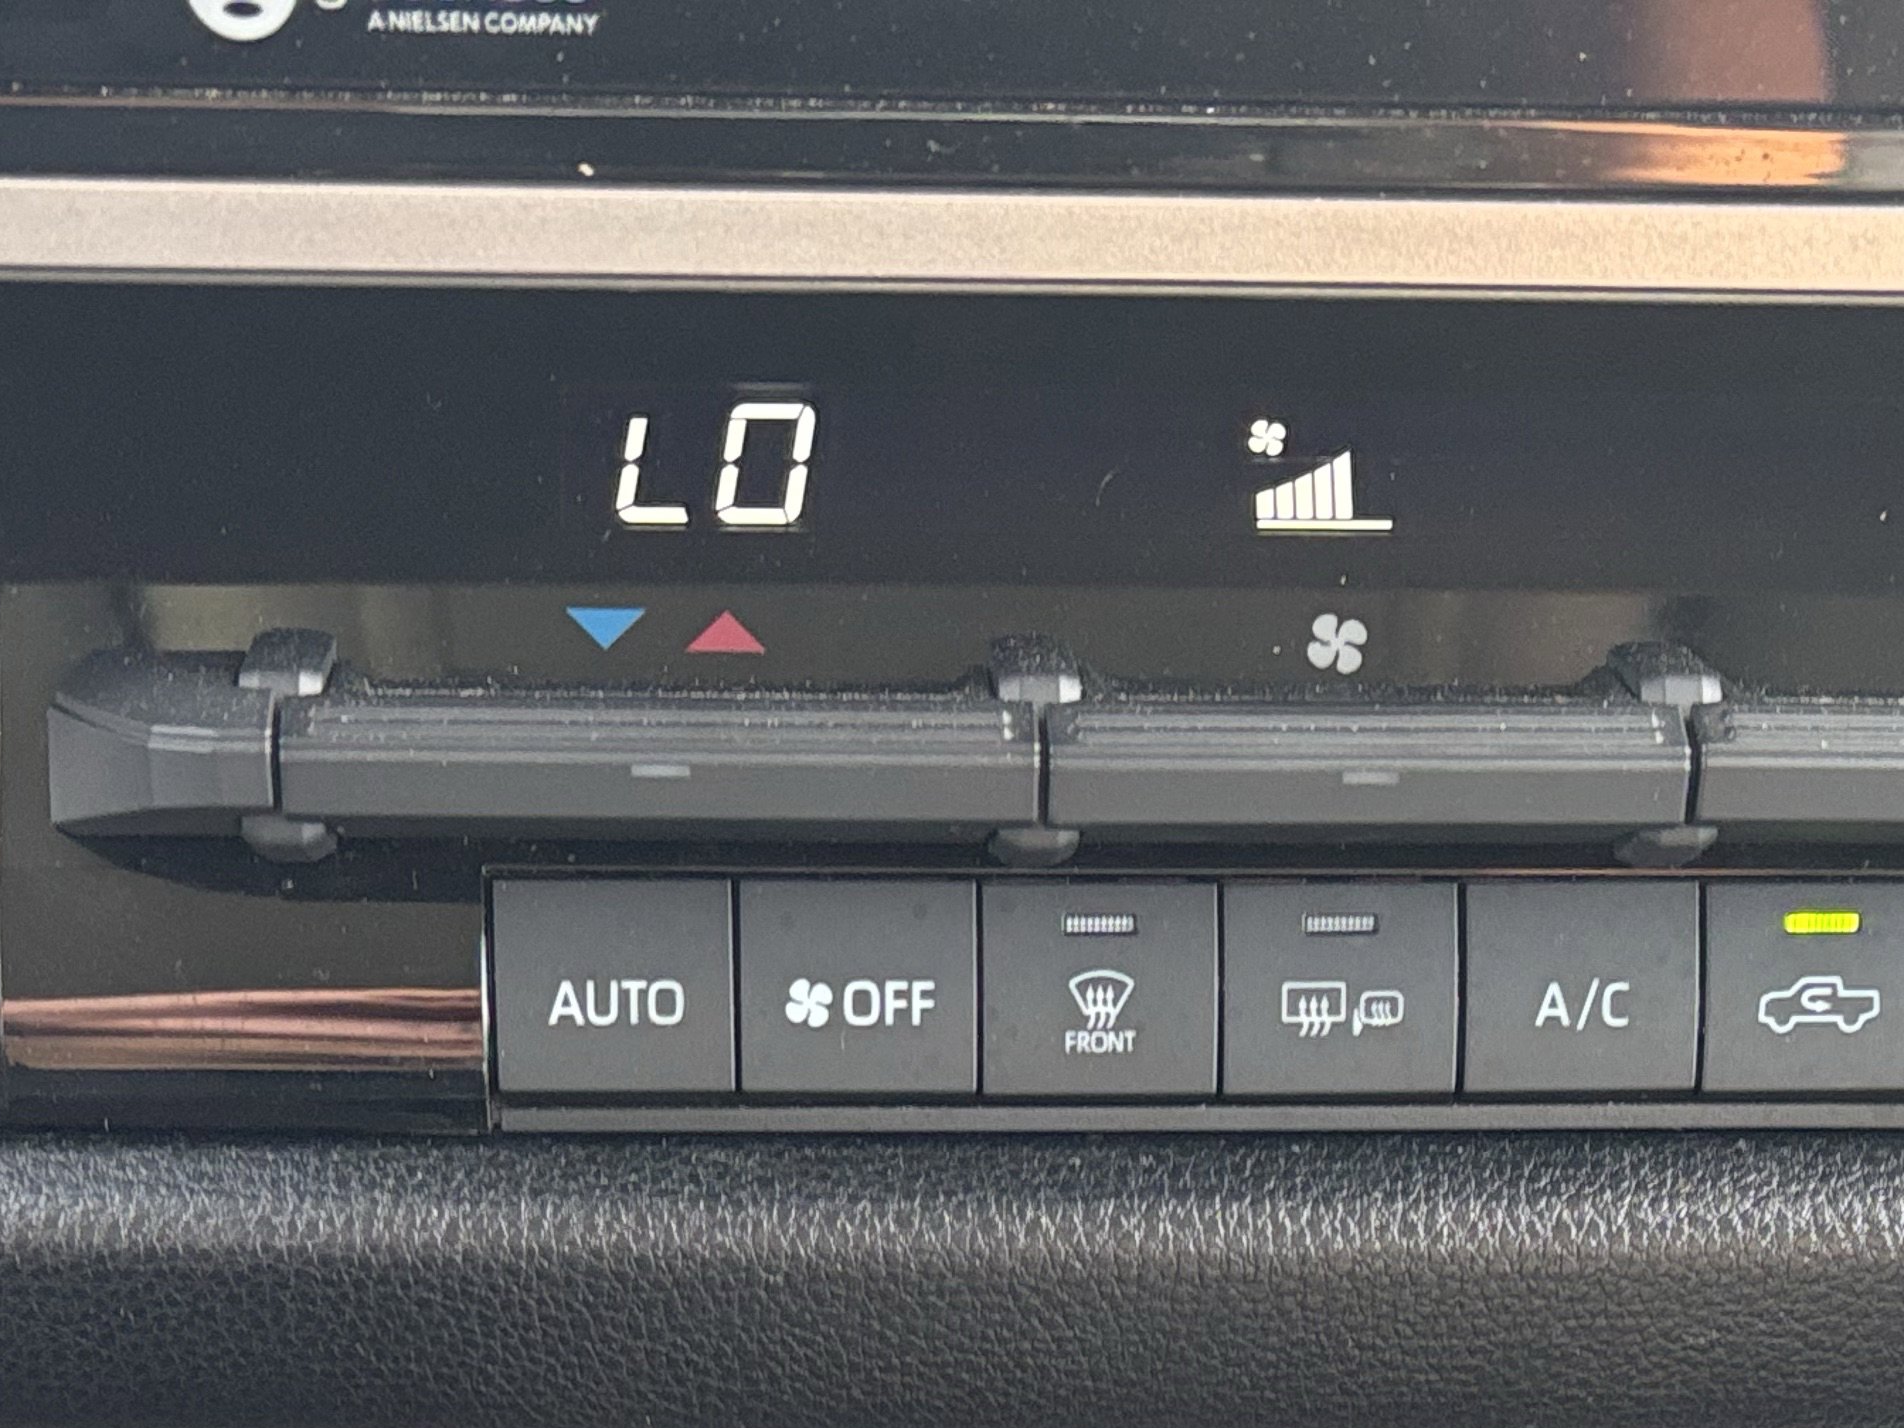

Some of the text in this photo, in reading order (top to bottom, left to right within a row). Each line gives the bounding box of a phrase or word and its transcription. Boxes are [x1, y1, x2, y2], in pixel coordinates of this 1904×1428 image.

[367, 9, 600, 36] A NIELSEN COMPANY
[547, 979, 686, 1027] AUTO
[842, 979, 936, 1027] OFF
[1534, 978, 1631, 1031] A/C
[1064, 1029, 1137, 1054] FRONT
